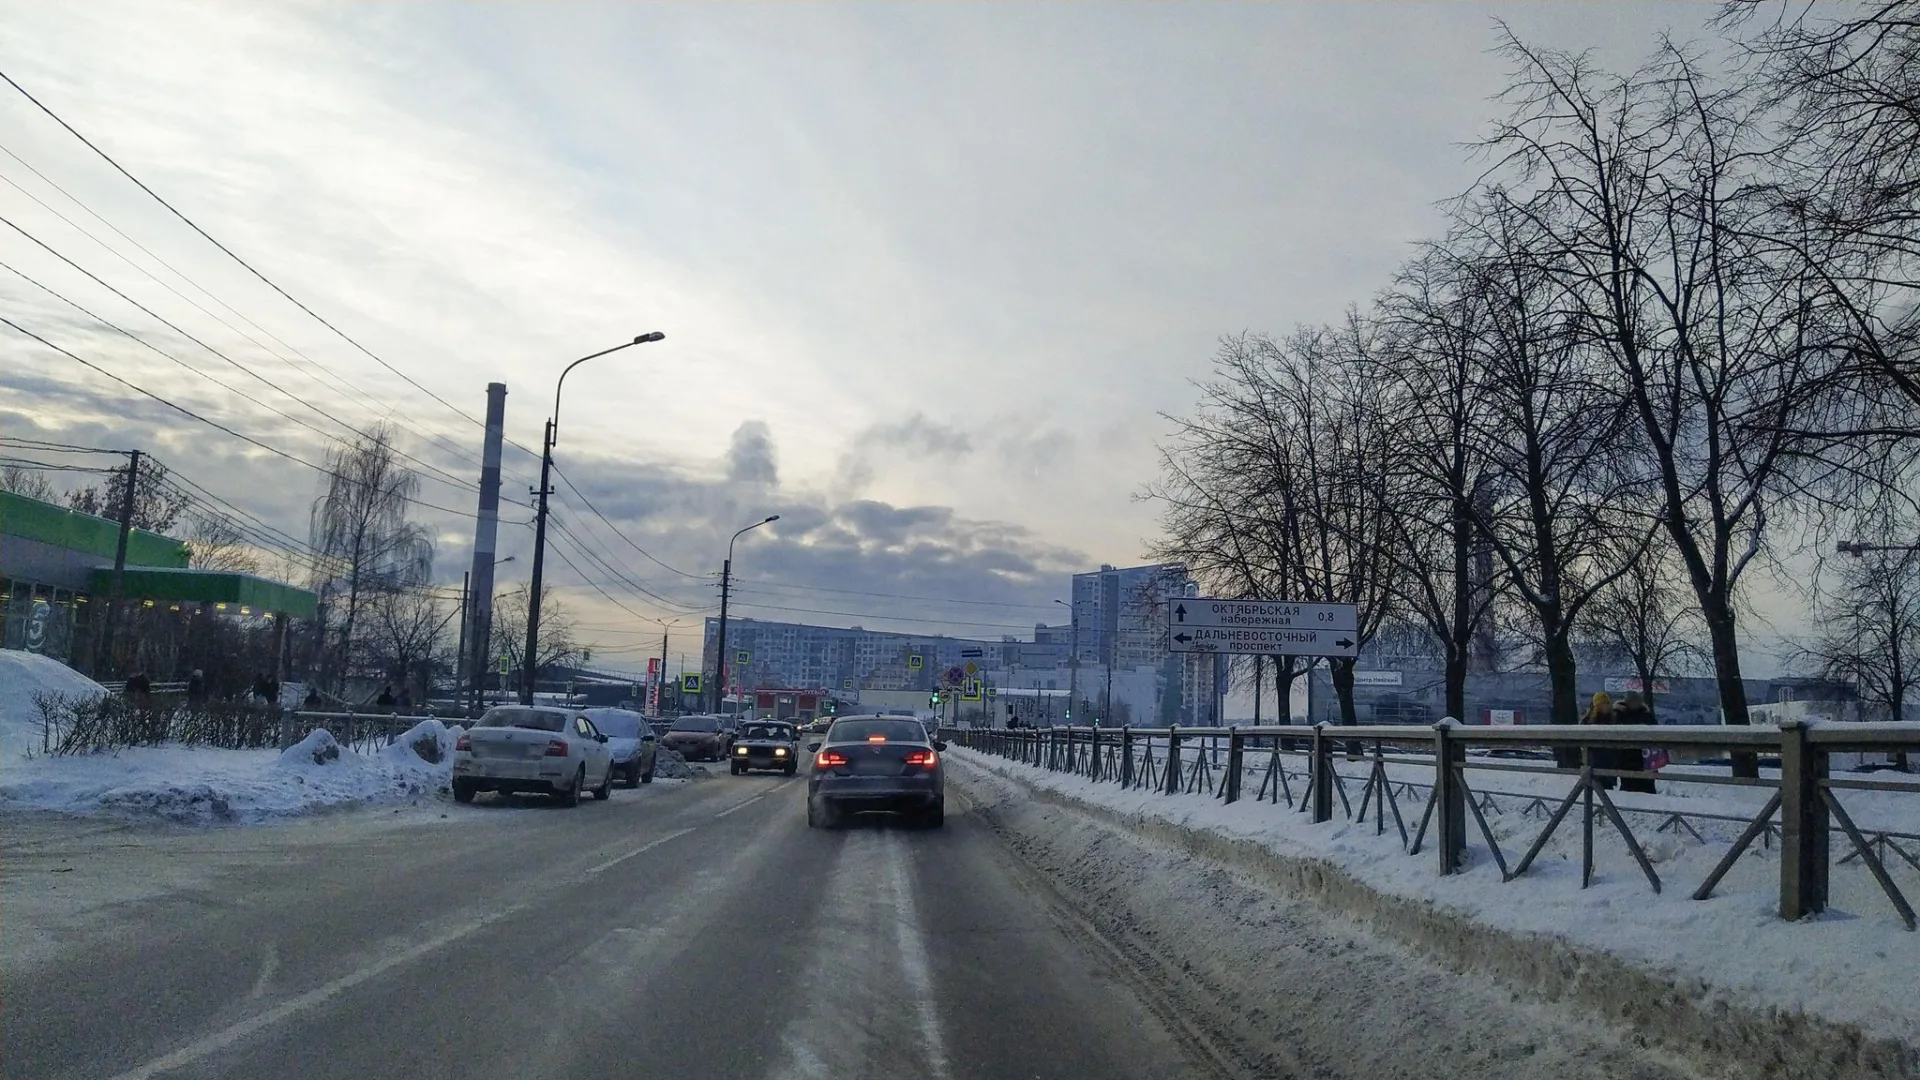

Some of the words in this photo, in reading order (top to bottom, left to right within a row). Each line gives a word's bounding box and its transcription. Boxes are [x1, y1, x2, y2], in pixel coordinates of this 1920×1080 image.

[1212, 604, 1300, 616] ОКТЯБРЬСКАЯ
[1221, 614, 1291, 625] набережная
[1194, 630, 1317, 643] ДАЛЬНЕВОСТОЧНЫЙ
[1230, 642, 1283, 651] проспект
